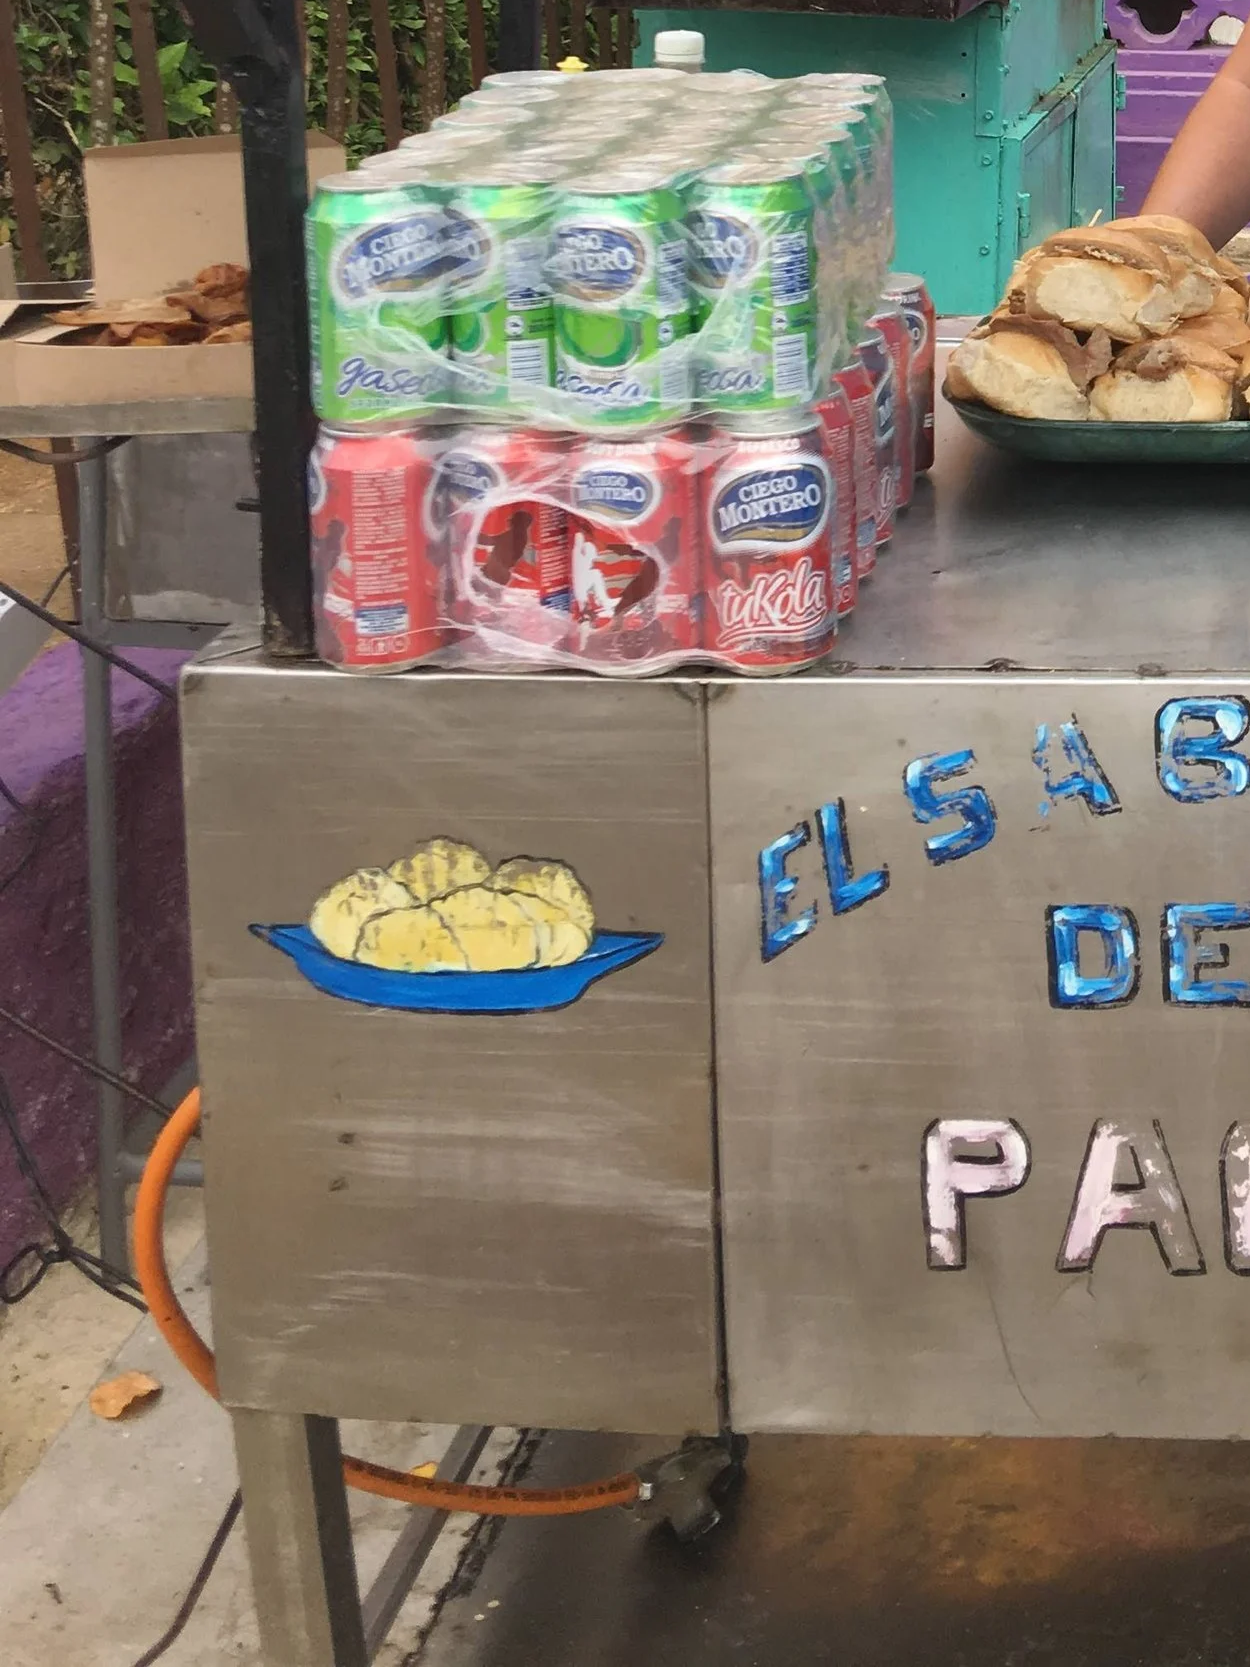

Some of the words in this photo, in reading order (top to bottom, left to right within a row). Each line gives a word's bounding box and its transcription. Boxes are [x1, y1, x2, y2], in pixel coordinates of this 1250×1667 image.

[718, 484, 822, 532] MONTERO
[738, 475, 798, 502] CIEGO
[719, 556, 826, 628] tuKola
[758, 796, 891, 964] EL
